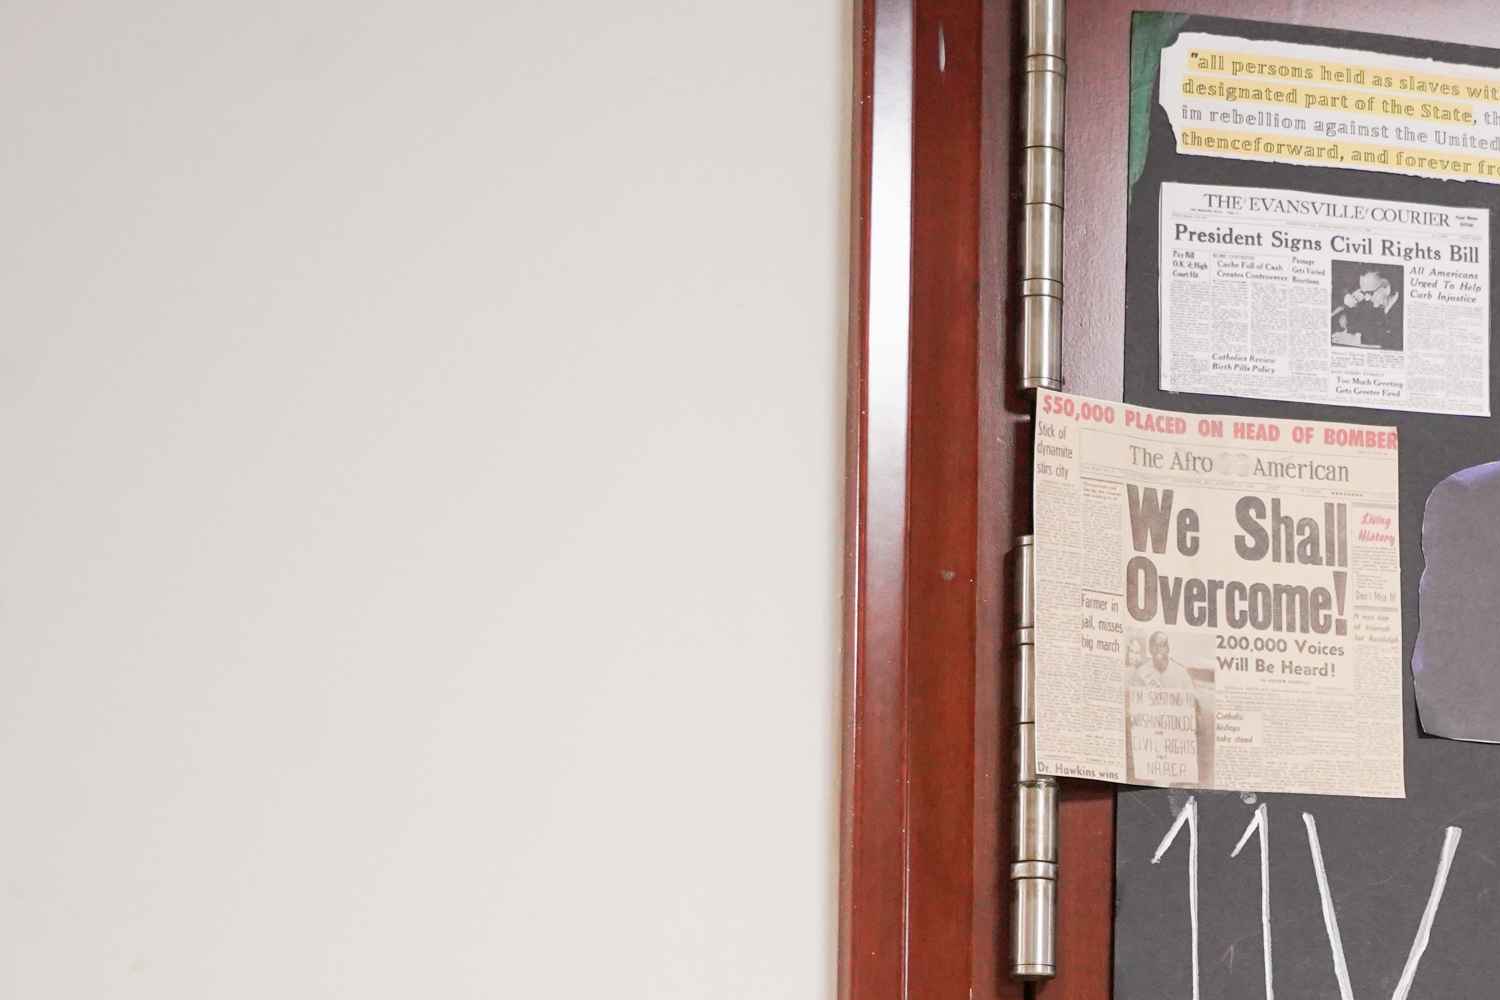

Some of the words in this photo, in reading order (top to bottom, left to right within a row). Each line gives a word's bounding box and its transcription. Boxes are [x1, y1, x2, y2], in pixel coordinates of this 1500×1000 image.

[1190, 52, 1225, 72] "all
[1232, 59, 1313, 80] persons
[1321, 65, 1365, 85] held
[1372, 75, 1393, 88] as
[1399, 75, 1460, 97] slaves
[1182, 79, 1298, 104] designated
[1305, 91, 1348, 109] part
[1354, 96, 1375, 111] of
[1382, 97, 1415, 117] the
[1420, 102, 1477, 126] State,
[1181, 105, 1202, 121] in
[1209, 108, 1307, 131] rebellion
[1313, 118, 1389, 139] against
[1395, 124, 1428, 143] the
[1434, 129, 1500, 152] United
[1181, 130, 1345, 162] thenceforward,
[1350, 148, 1389, 165] and
[1395, 150, 1473, 175] forever
[1203, 193, 1243, 210] THE
[1250, 197, 1365, 220] EVANSVILLE
[1371, 207, 1450, 228] COURIER
[1175, 223, 1263, 248] President
[1271, 231, 1322, 252] Signs
[1331, 235, 1372, 255] Civil
[1381, 239, 1441, 262] Rights
[1450, 244, 1479, 264] Bill
[1409, 266, 1424, 276] All
[1429, 268, 1478, 280] Americans
[1444, 281, 1456, 290] To
[1038, 421, 1055, 438] Stick
[1058, 426, 1067, 441] of
[1043, 395, 1115, 424] $50,000
[1125, 410, 1187, 435] PLACED
[1198, 419, 1223, 438] ON
[1233, 422, 1281, 442] HEAD
[1291, 426, 1315, 445] OF
[1323, 428, 1398, 450] BOMBER
[1129, 445, 1164, 469] The
[1169, 451, 1213, 473] Afro
[1253, 457, 1350, 482] American
[1126, 483, 1200, 558] We
[1234, 496, 1348, 568] Shall
[1126, 555, 1348, 637] Overcome!
[1216, 656, 1249, 673] Will
[1255, 658, 1275, 674] Be
[1281, 660, 1336, 677] Heard!
[1294, 639, 1345, 657] Voices
